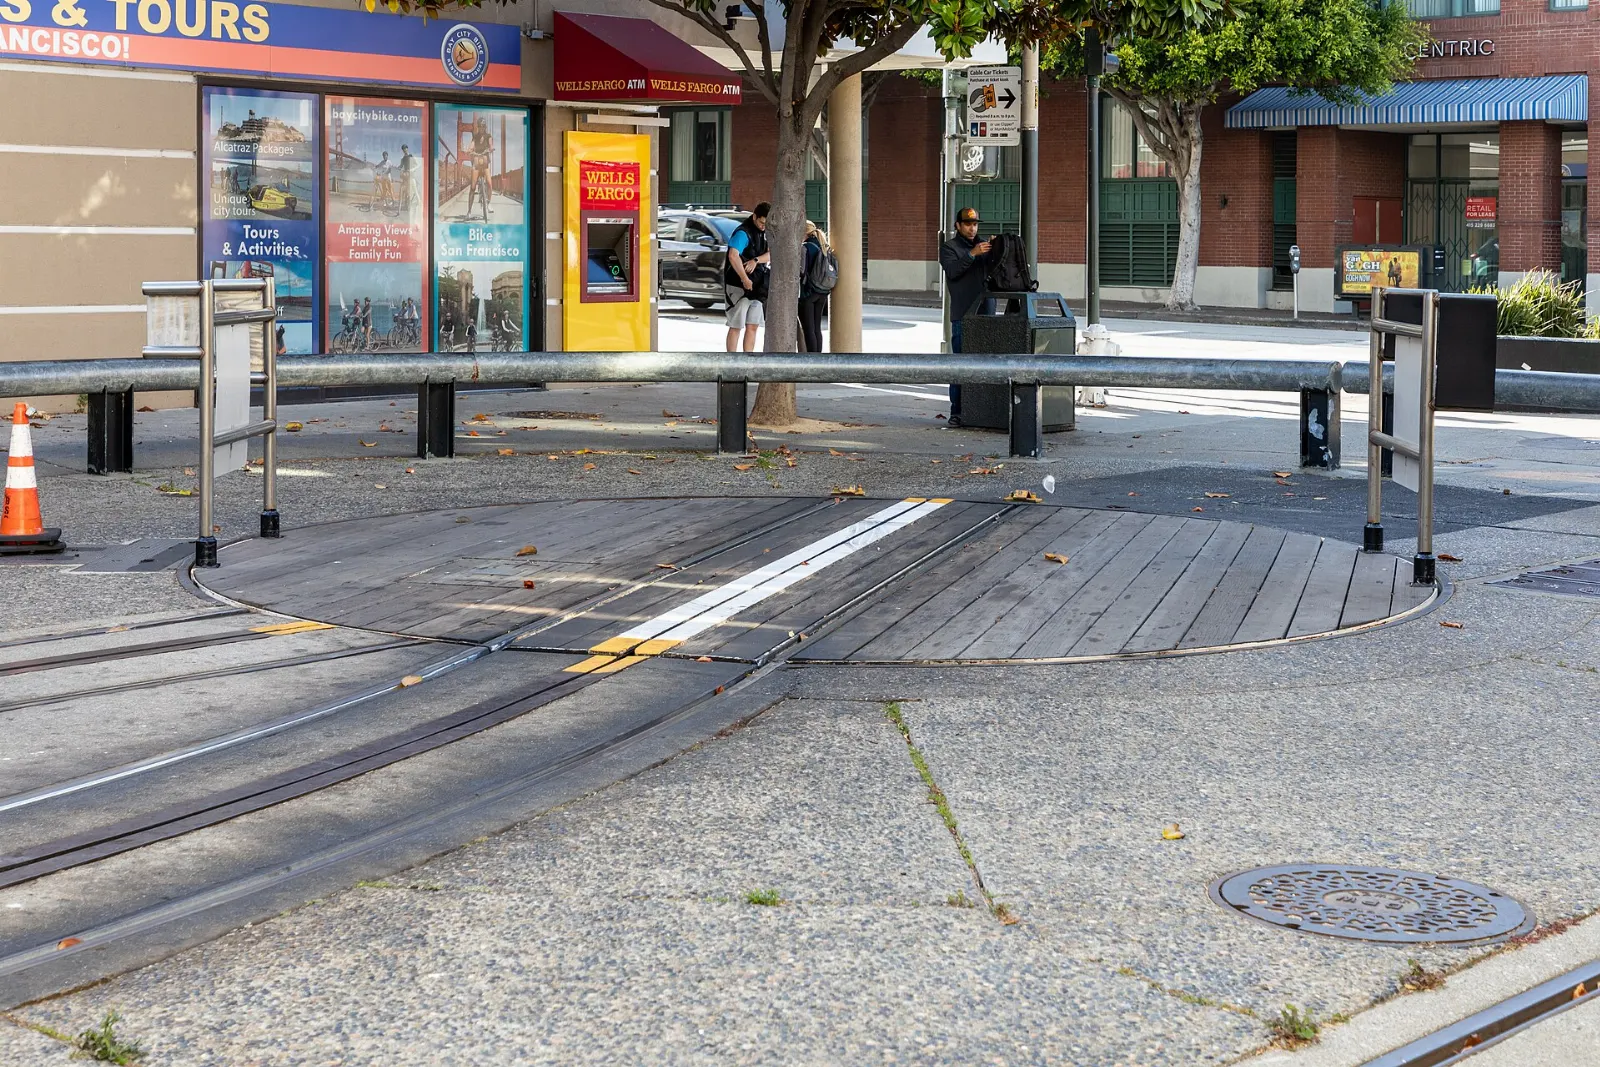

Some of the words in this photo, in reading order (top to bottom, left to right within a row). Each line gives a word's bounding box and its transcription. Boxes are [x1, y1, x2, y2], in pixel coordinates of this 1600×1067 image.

[51, 0, 88, 28] &
[105, 0, 270, 42] TOURS
[556, 80, 591, 91] WELLS
[592, 80, 626, 91] FARGO
[627, 79, 645, 90] ATM
[650, 79, 686, 91] WELLS
[687, 82, 721, 94] FARGO
[722, 84, 740, 95] ATM
[332, 108, 418, 123] baycitybike.com
[214, 141, 251, 153] Alcatraz
[253, 143, 294, 156] Packages
[585, 171, 635, 185] WELLS
[214, 194, 248, 205] Unique
[587, 187, 635, 200] FARGO
[214, 206, 230, 218] city
[233, 207, 256, 216] tours
[243, 224, 279, 239] Tours
[338, 224, 381, 237] Amazing
[384, 224, 413, 236] Views
[469, 228, 493, 241] Bike
[222, 242, 233, 256] &
[237, 241, 300, 256] Activities
[351, 237, 369, 247] Flat
[372, 237, 400, 249] Paths,
[440, 243, 463, 256] San
[466, 243, 519, 256] Francisco
[349, 249, 382, 262] Family
[385, 249, 402, 260] Fun
